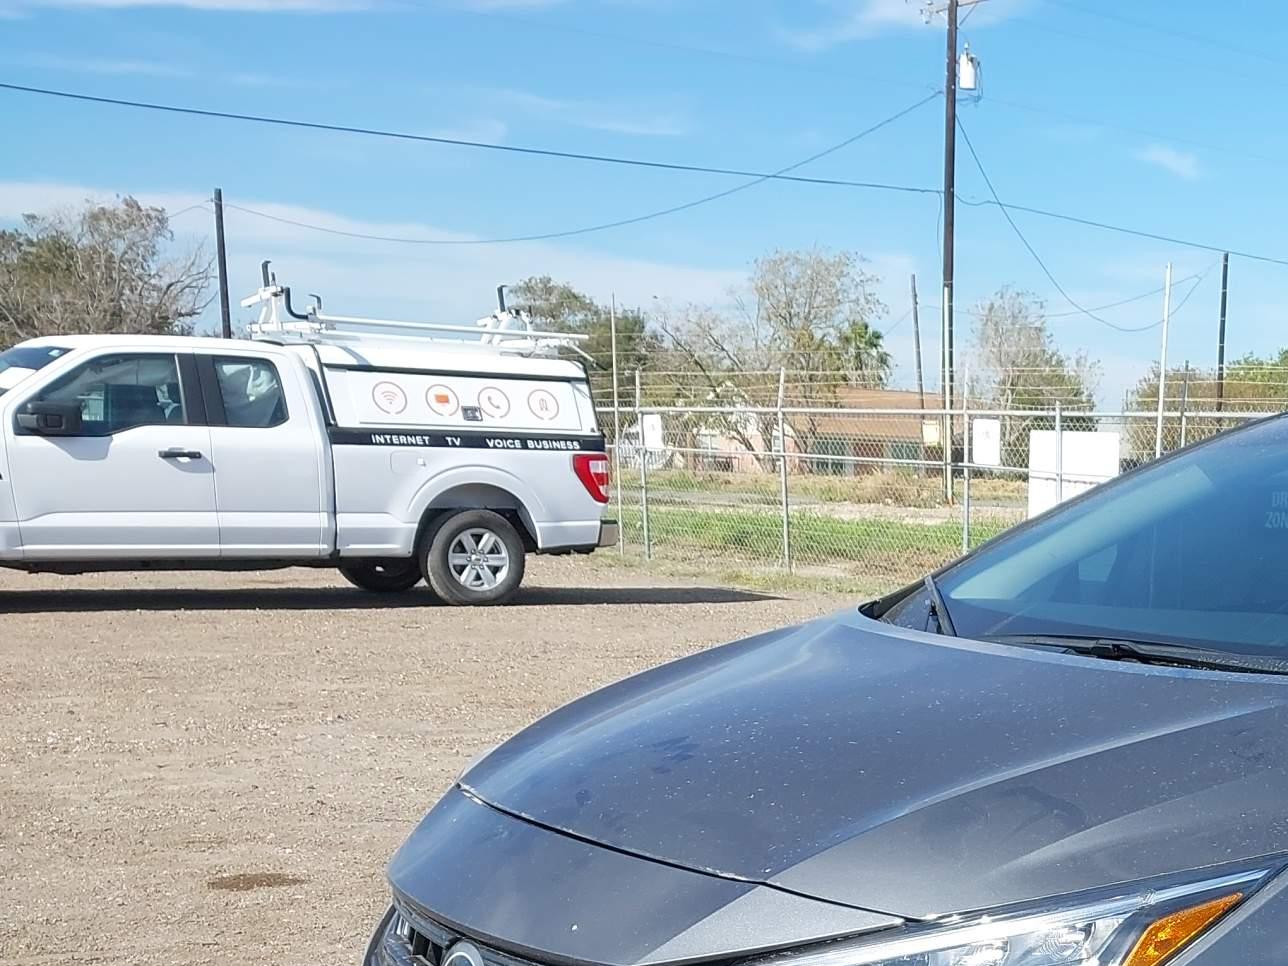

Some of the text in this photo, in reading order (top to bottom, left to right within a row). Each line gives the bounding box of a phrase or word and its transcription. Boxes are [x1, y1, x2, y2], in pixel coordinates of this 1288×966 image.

[371, 434, 581, 450] INTERNET TV VOICE BUSINESS
